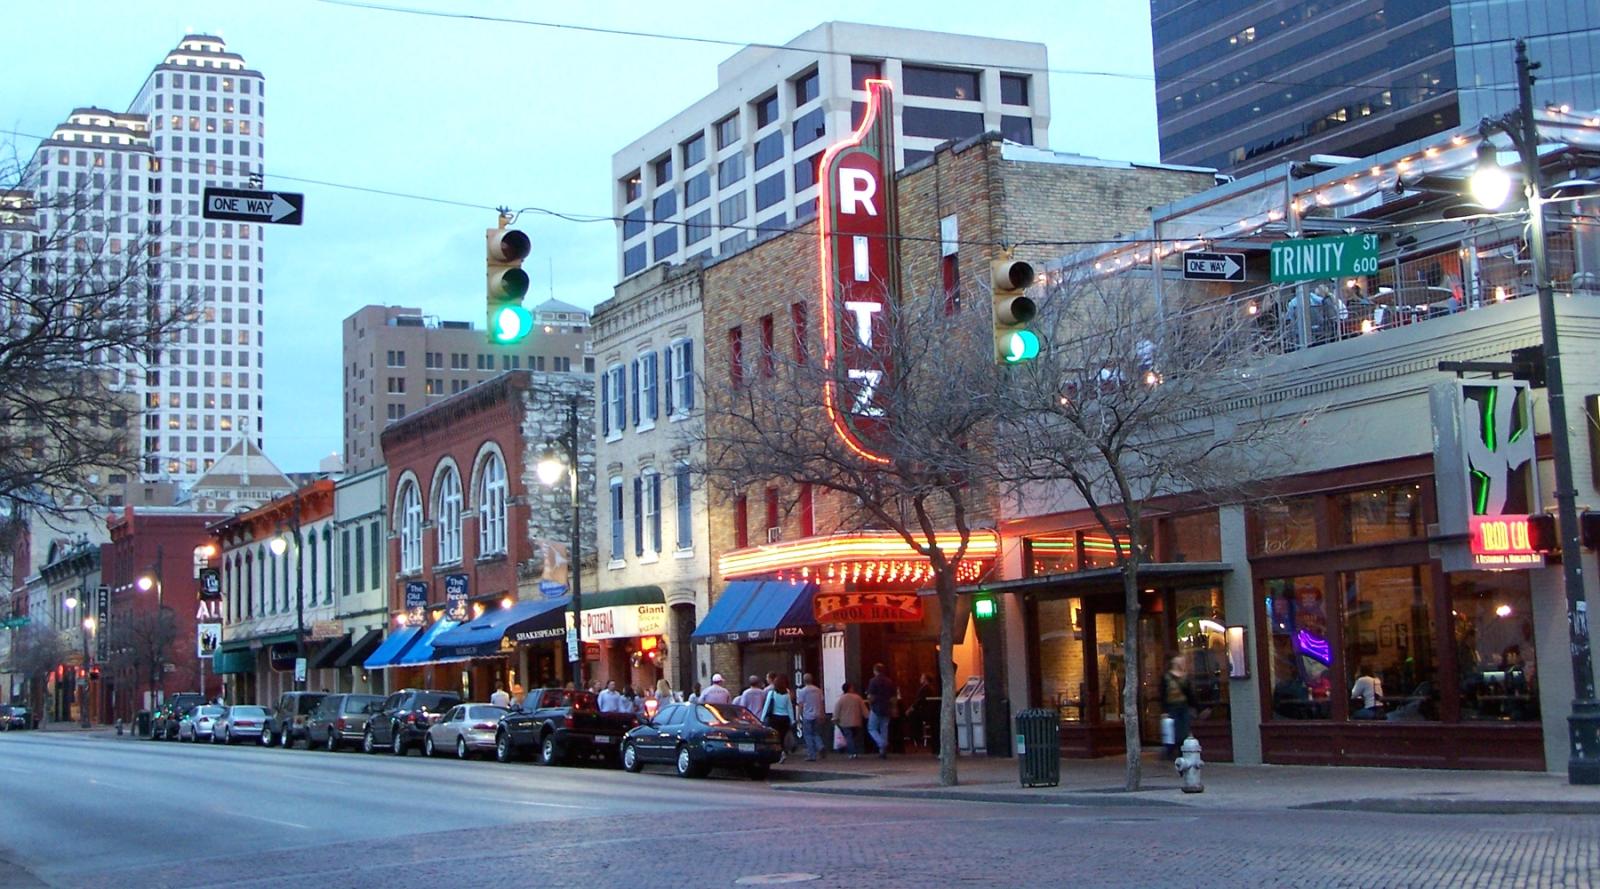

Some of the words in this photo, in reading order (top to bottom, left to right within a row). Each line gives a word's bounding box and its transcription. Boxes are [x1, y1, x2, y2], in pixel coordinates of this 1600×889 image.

[214, 197, 239, 211] ONE
[246, 199, 273, 213] WAY
[1272, 242, 1345, 277] TRINITY
[1363, 234, 1378, 250] ST
[1190, 260, 1206, 272] ONE
[1210, 260, 1227, 273] WAY
[1353, 257, 1377, 273] 600
[838, 167, 885, 417] RITZ
[451, 578, 464, 586] The
[410, 585, 423, 593] The
[447, 586, 461, 594] Old
[638, 605, 665, 615] Giant
[817, 593, 920, 619] RITZ
[833, 607, 865, 620] POOL
[587, 609, 614, 637] PIZZERIA
[778, 627, 804, 636] PIZZA
